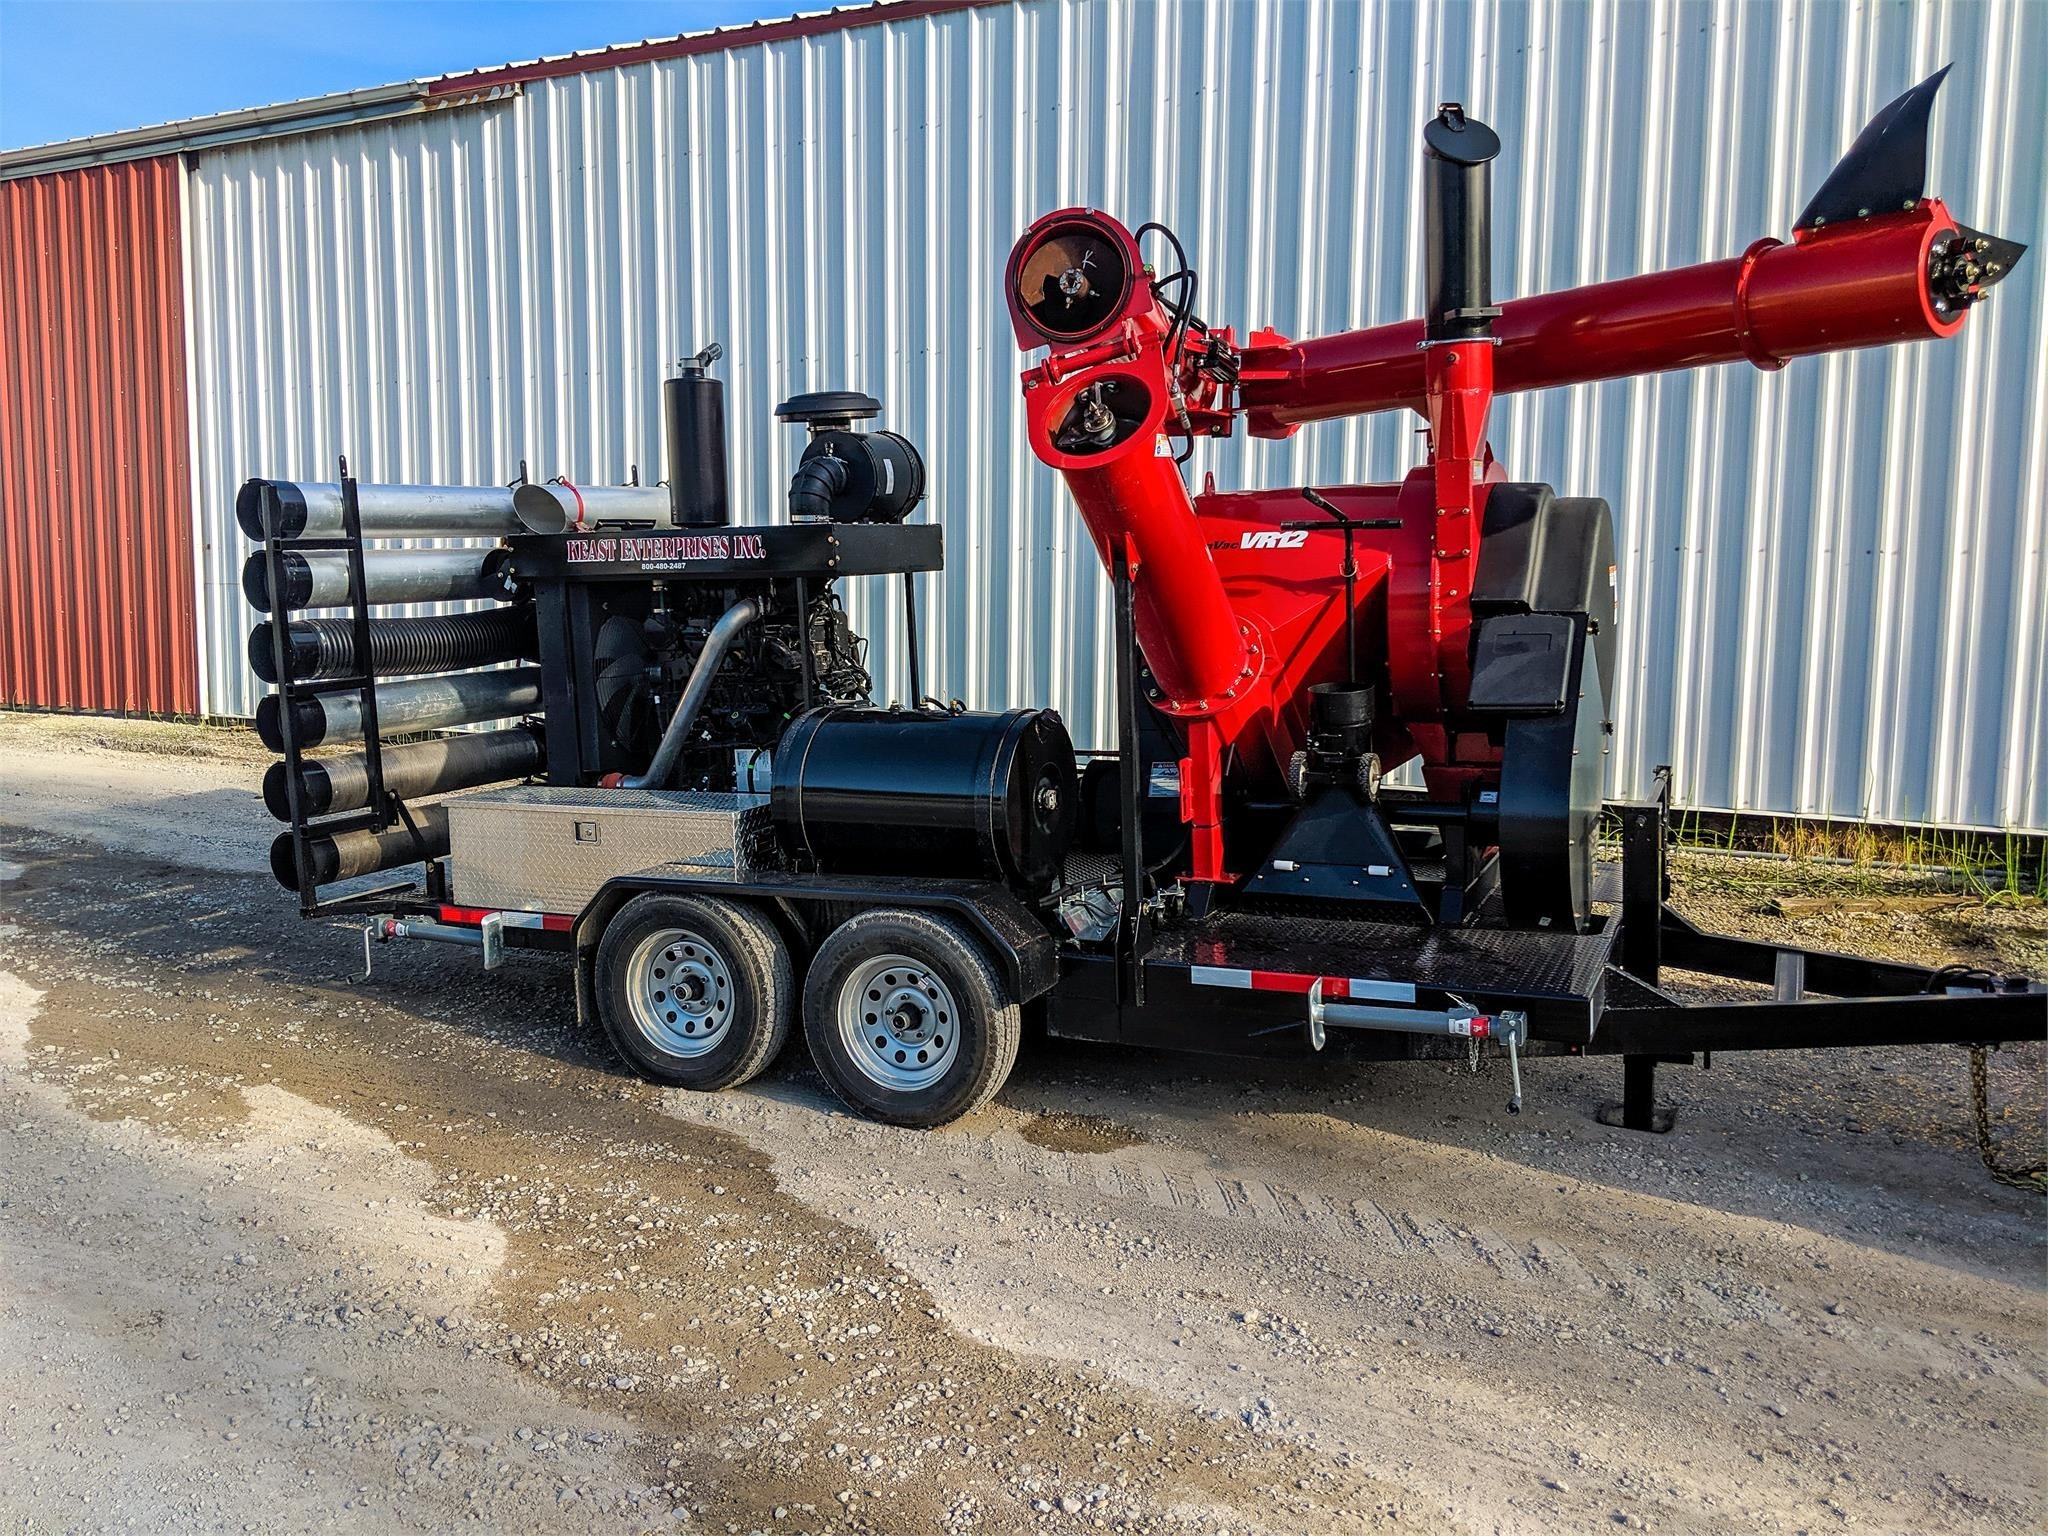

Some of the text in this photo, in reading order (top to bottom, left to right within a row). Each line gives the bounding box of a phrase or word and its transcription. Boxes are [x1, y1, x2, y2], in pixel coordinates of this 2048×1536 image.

[567, 534, 767, 562] KEAST ENTERPRISES INC.
[1240, 530, 1309, 549] VR12
[641, 562, 686, 570] 800-480-2487
